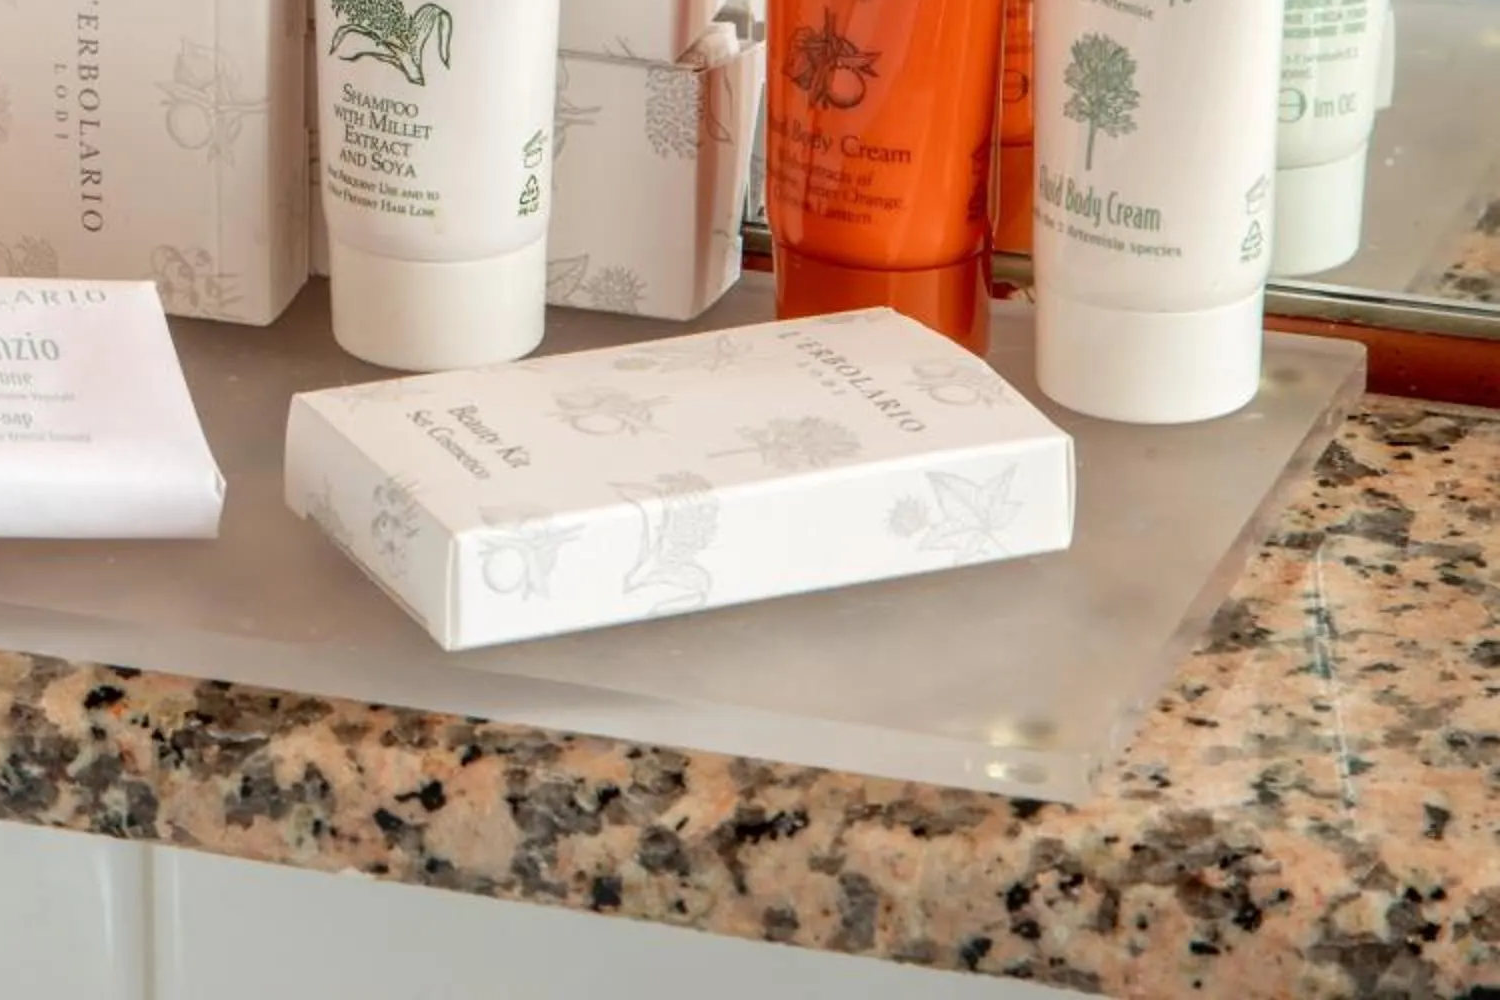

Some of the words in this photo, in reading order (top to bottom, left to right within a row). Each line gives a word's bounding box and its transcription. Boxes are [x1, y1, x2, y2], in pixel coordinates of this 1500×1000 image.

[53, 63, 70, 141] LODI
[342, 83, 419, 118] SHAMPOO
[344, 125, 413, 157] EXTRACT
[369, 111, 433, 141] MILLET
[841, 134, 913, 164] Cream
[371, 153, 417, 179] SOYA
[1065, 176, 1102, 229] Body
[1107, 189, 1162, 233] Cream
[778, 331, 928, 434] L'ERBOLARIO
[497, 444, 531, 469] Kit
